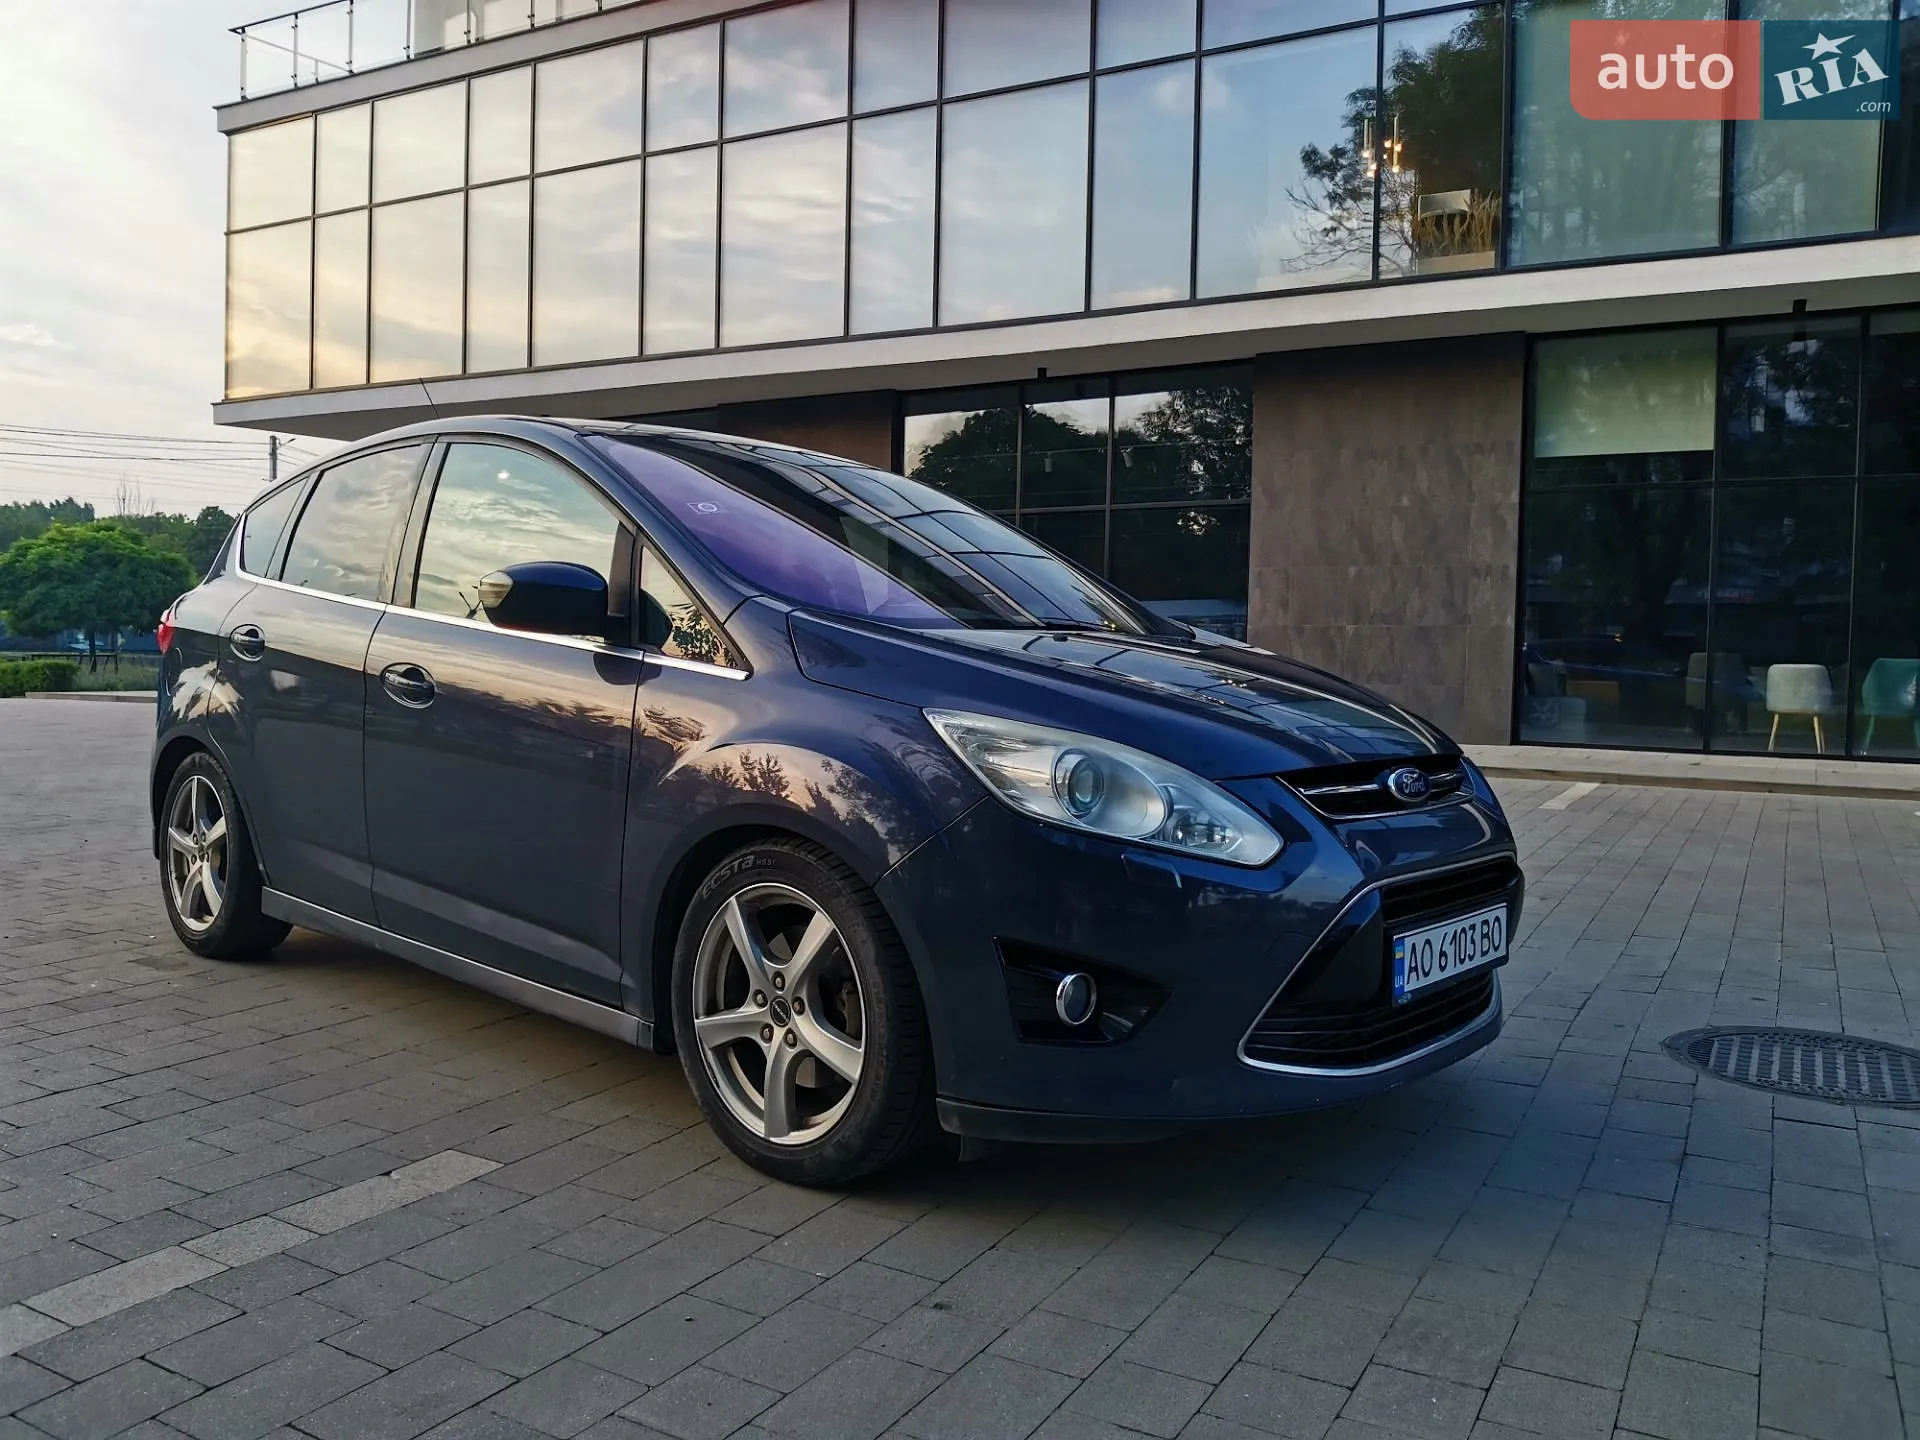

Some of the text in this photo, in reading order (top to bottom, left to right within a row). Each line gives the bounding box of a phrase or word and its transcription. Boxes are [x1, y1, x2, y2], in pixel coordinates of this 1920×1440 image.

[1403, 773, 1425, 793] Ford
[1406, 915, 1502, 985] AO 6103 BO
